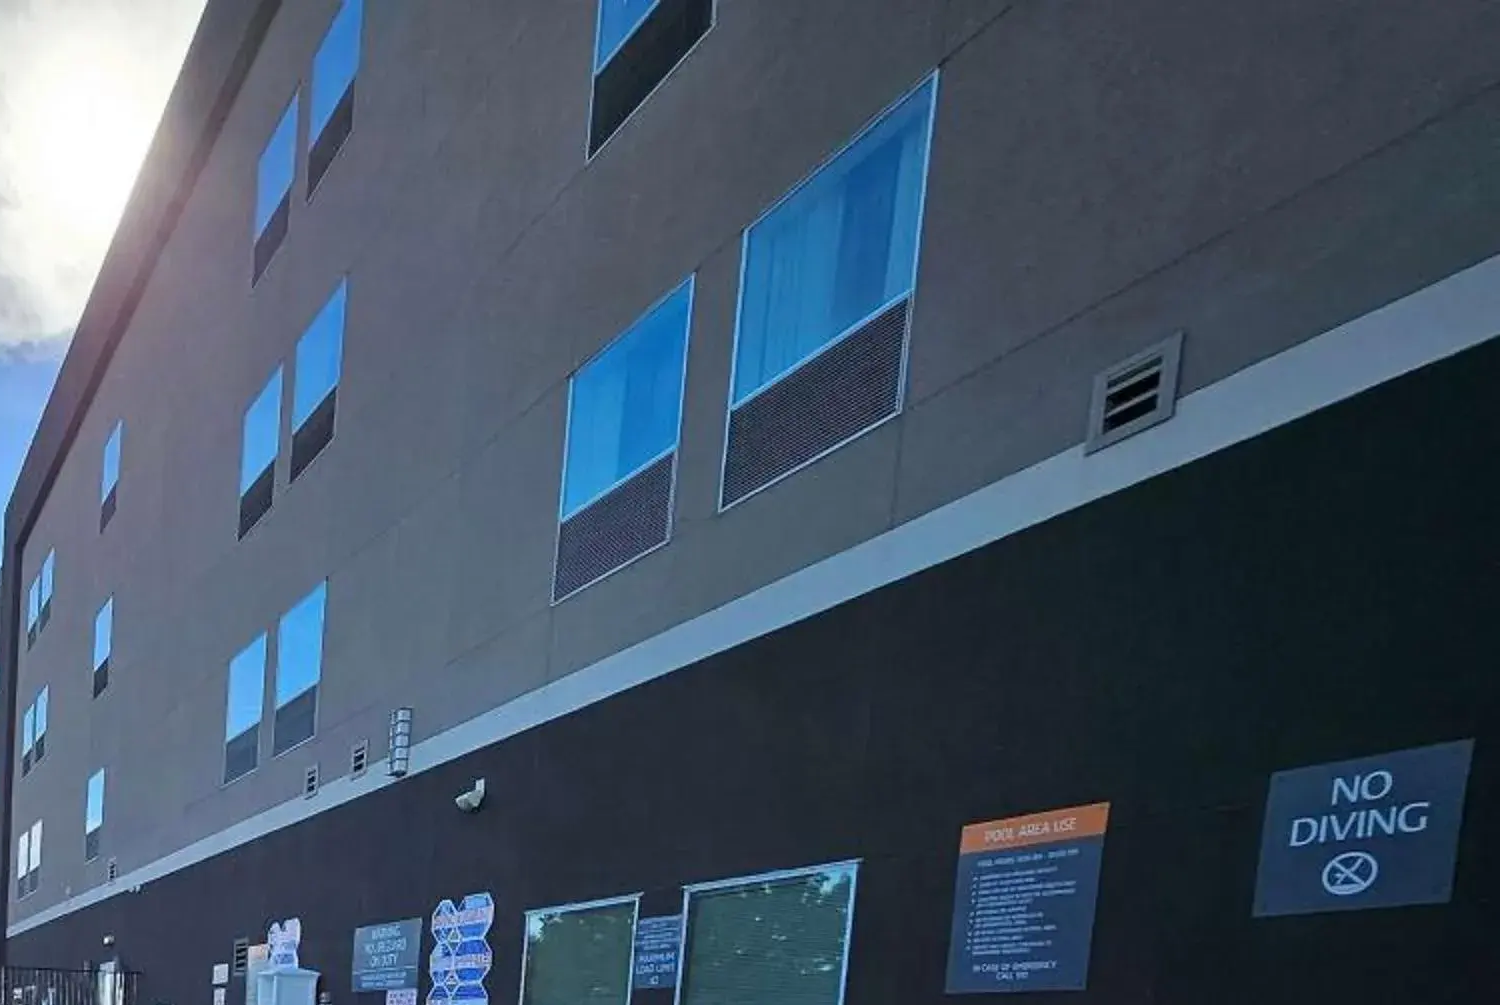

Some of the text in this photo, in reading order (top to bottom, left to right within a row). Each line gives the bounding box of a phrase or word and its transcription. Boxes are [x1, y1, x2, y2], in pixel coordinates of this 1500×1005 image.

[1331, 770, 1393, 806] NO
[1018, 822, 1051, 837] AREA
[1054, 817, 1077, 832] USE
[1289, 802, 1431, 847] DIVING
